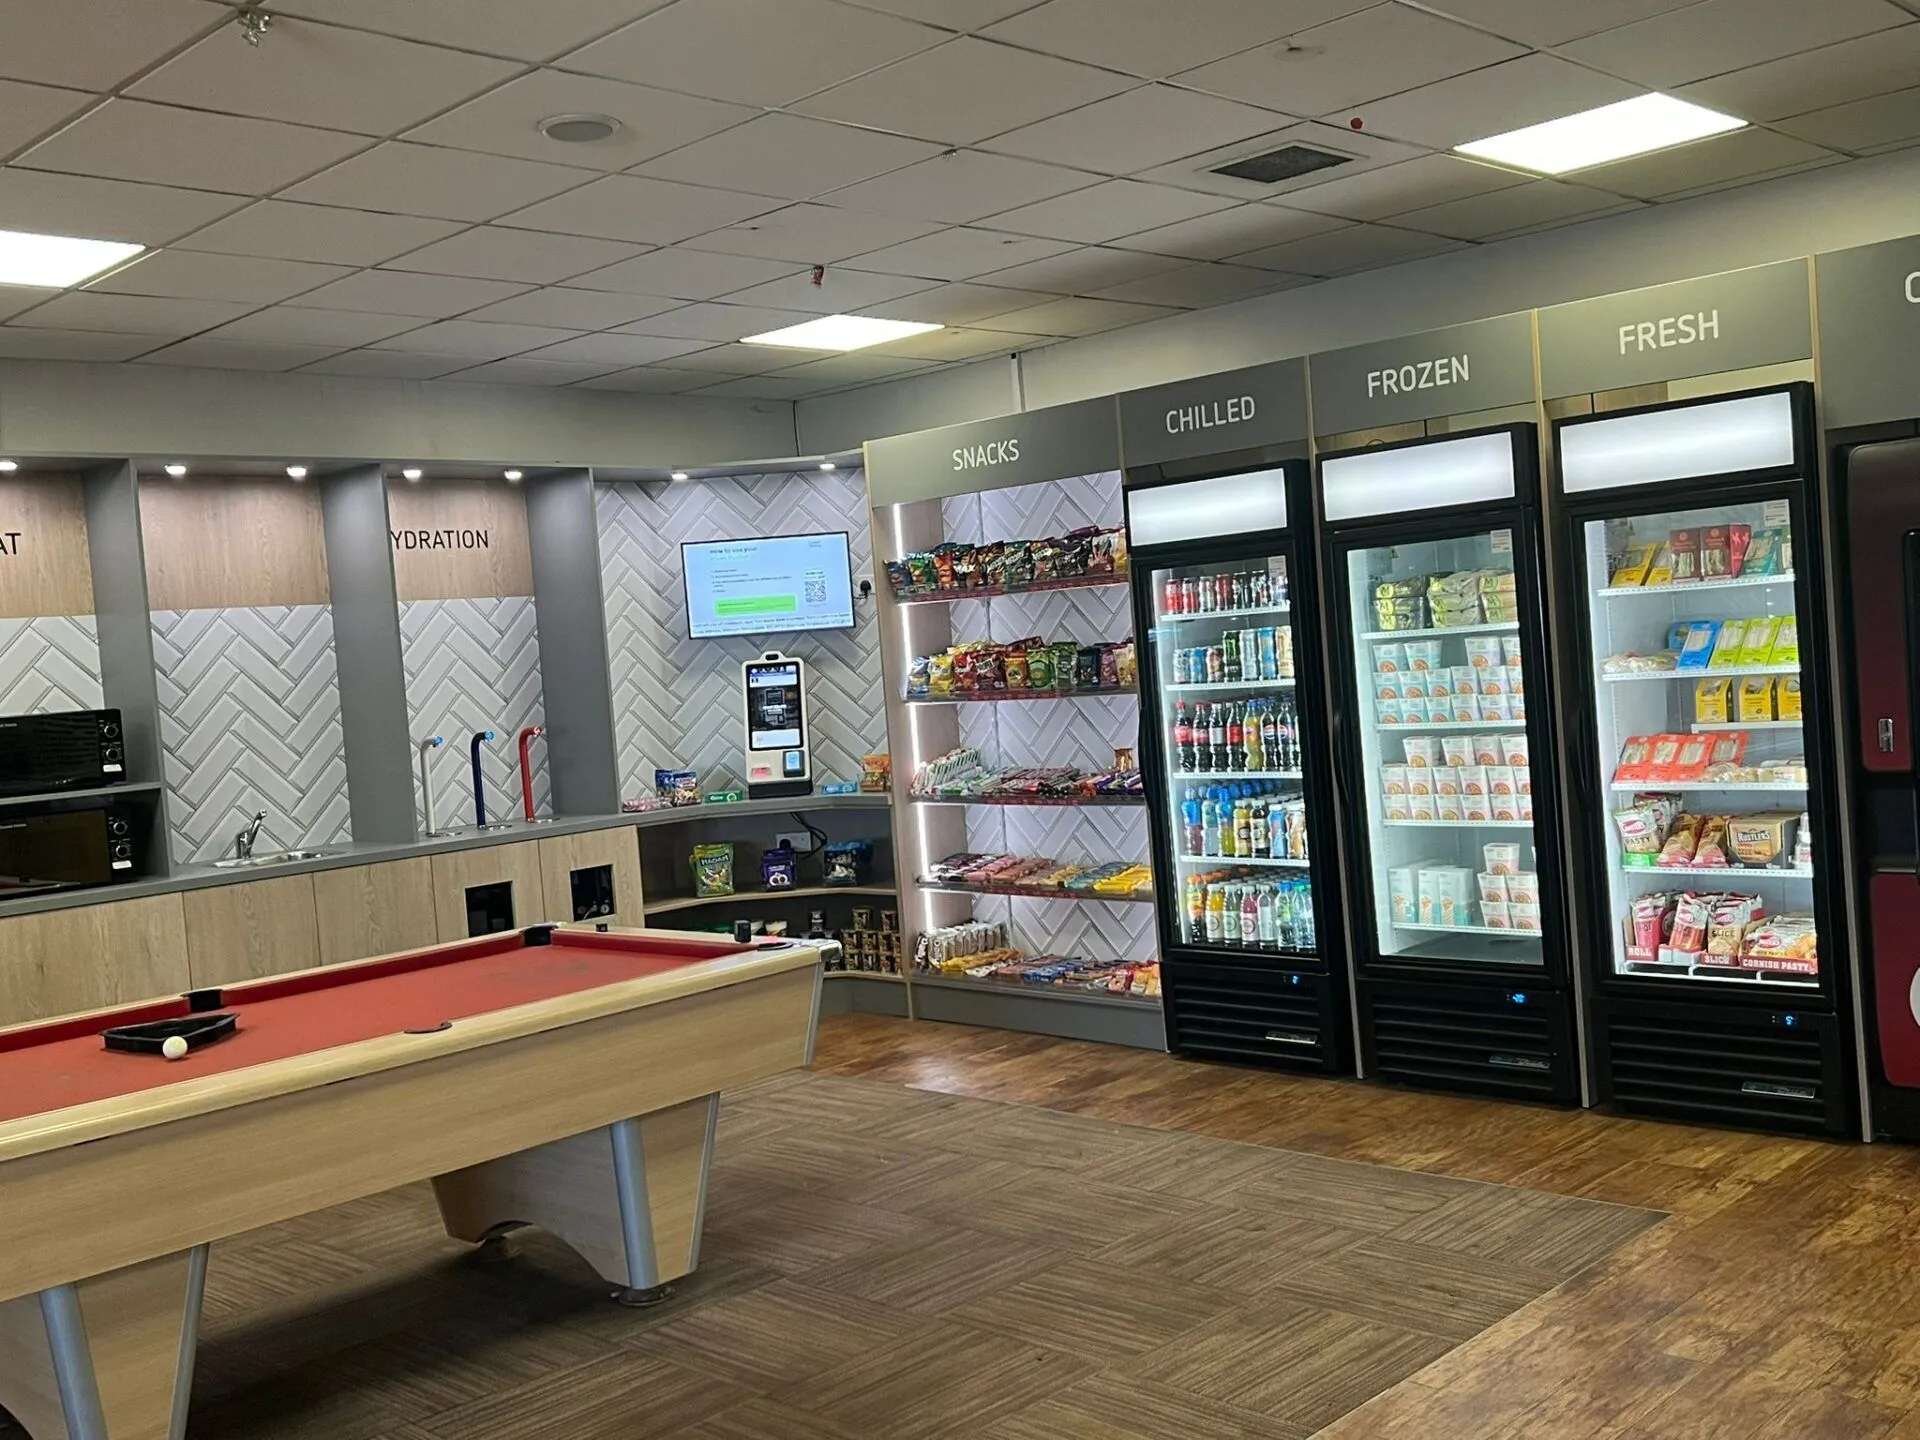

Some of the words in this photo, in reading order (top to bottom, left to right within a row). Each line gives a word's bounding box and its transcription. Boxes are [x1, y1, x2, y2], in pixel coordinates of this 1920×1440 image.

[1619, 309, 1719, 355] FRESH
[1367, 354, 1470, 398] FROZEN
[1166, 395, 1255, 434] CHILLED
[952, 439, 1020, 471] SNACKS
[390, 529, 489, 550] YDRATION
[1711, 930, 1736, 938] SLICE
[1628, 947, 1652, 957] ROLL
[1742, 958, 1780, 969] CORNISH
[1781, 961, 1810, 972] PASTY
